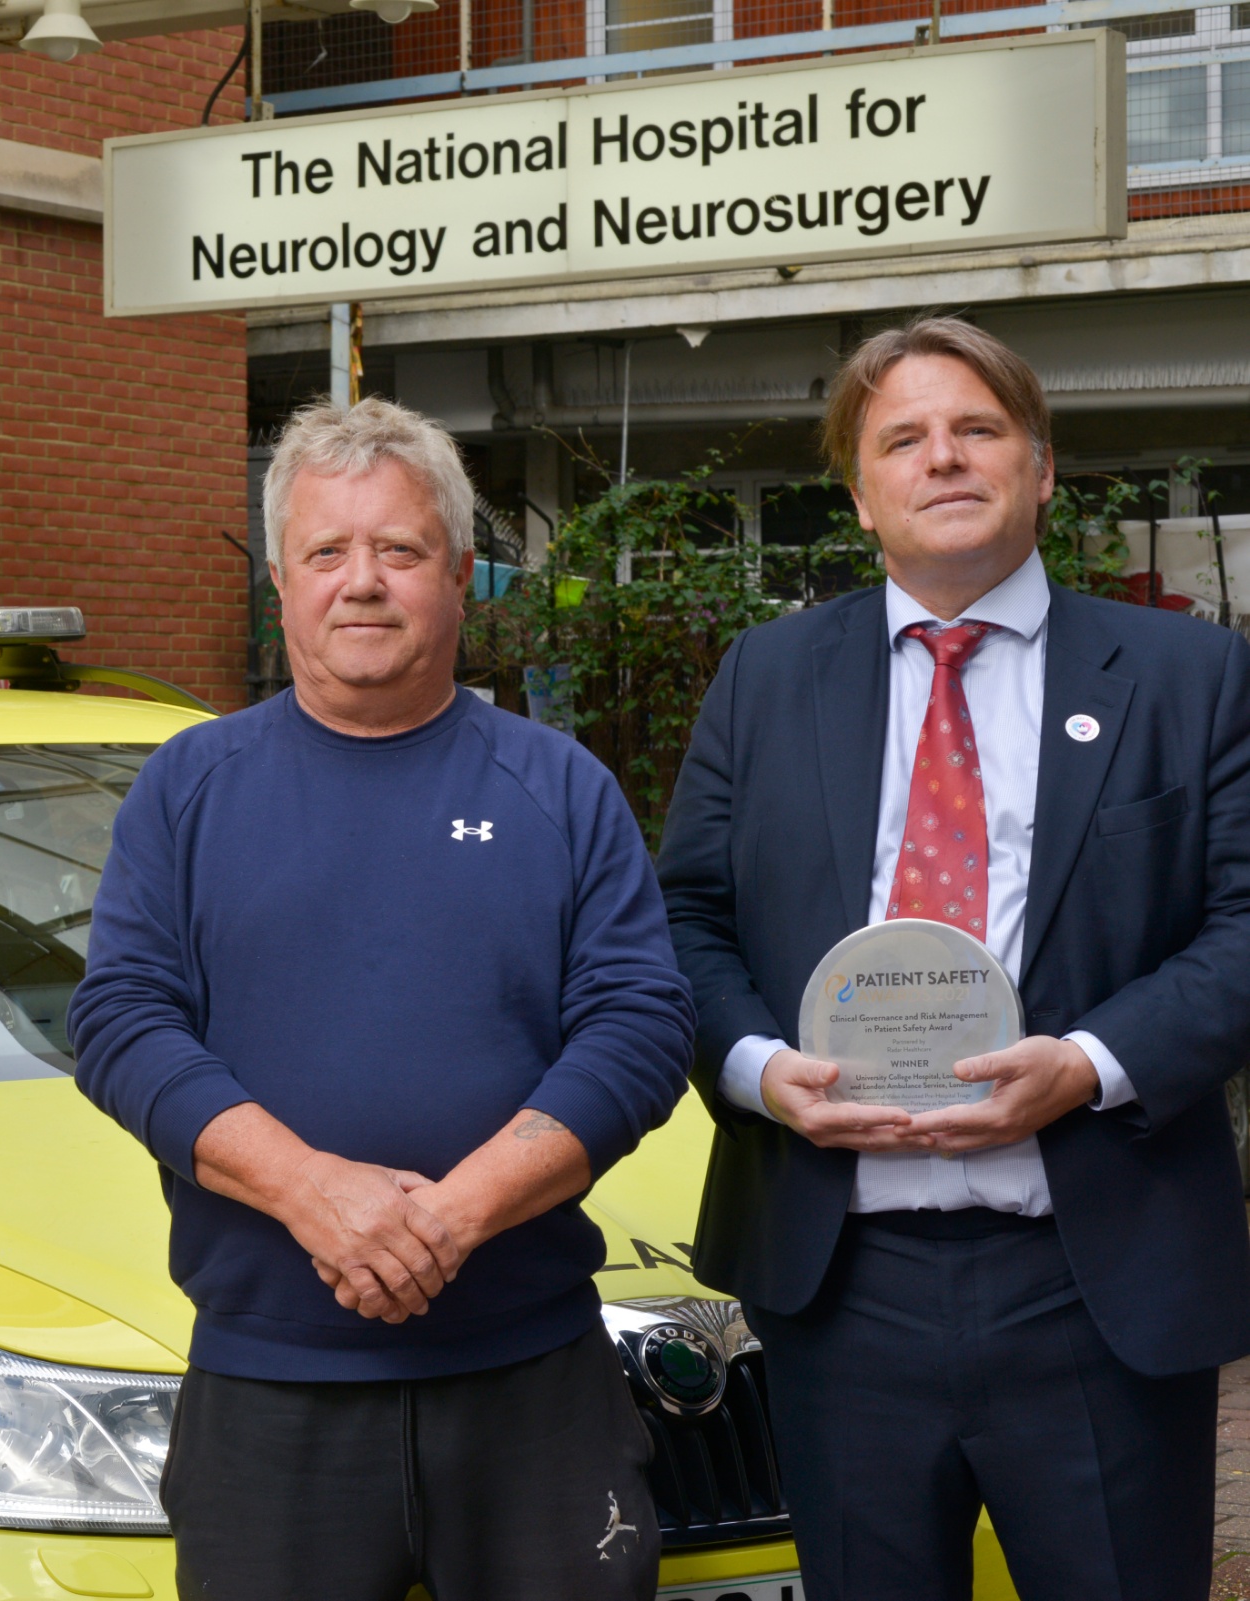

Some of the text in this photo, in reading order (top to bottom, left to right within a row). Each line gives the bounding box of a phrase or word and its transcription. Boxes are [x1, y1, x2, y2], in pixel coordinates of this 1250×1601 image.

[241, 87, 927, 199] The National Hospital for
[191, 174, 992, 281] Neurology and Neurosurgery
[856, 969, 990, 987] PATIENT SAFETY
[857, 986, 971, 1003] AWARDS 2021
[829, 1011, 988, 1023] Clinical Governance and Risk Management
[864, 1023, 953, 1034] in Patient Safety Award
[890, 1059, 929, 1068] WINNER
[855, 1074, 887, 1082] University
[888, 1073, 912, 1082] College
[913, 1073, 941, 1082] Hospital,
[923, 1081, 948, 1090] Service,
